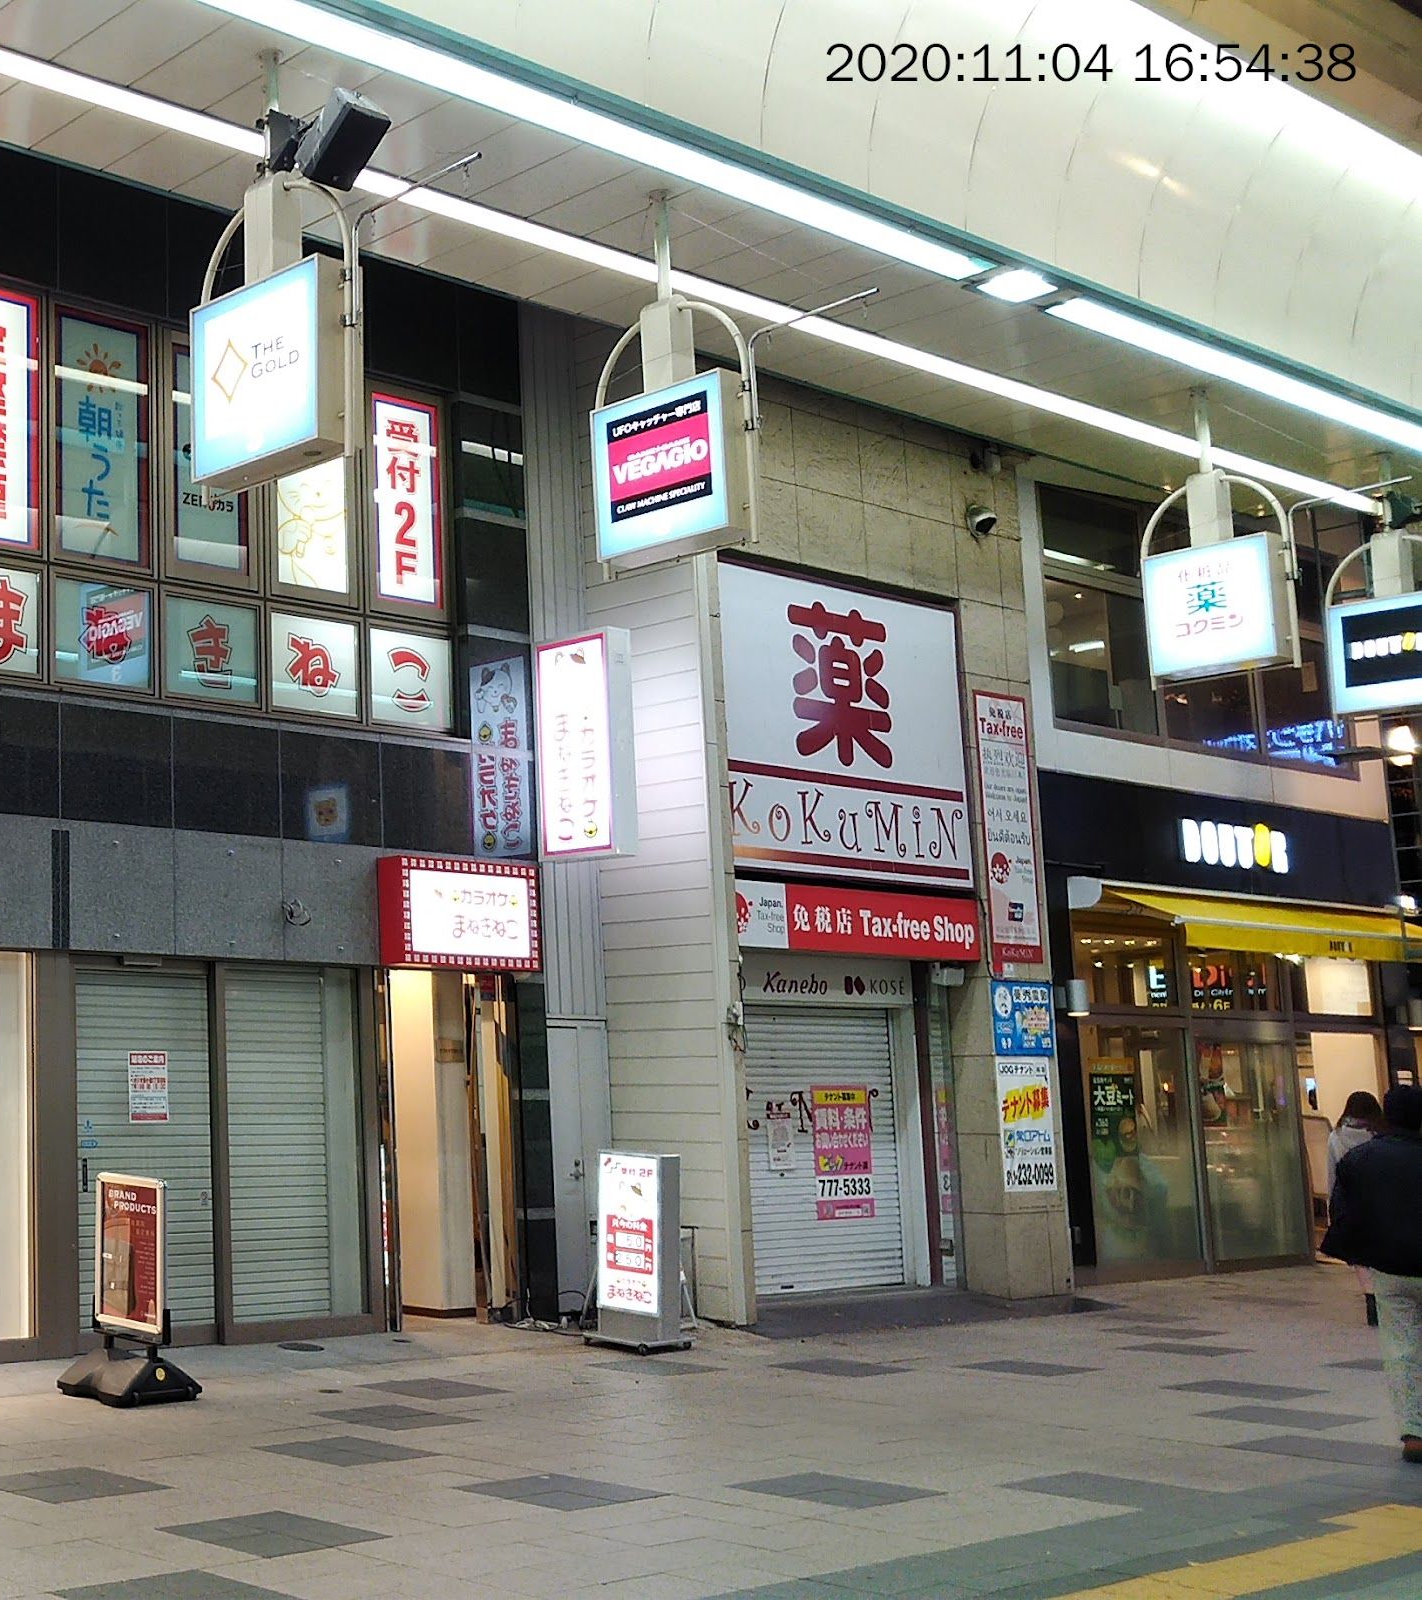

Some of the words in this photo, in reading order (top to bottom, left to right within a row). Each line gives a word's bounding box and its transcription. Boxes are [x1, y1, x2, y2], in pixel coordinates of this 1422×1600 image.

[251, 335, 285, 360] THE
[251, 349, 301, 380] GOLD
[77, 395, 113, 521] 朝うた
[612, 438, 709, 485] VEGAGIO
[1186, 580, 1228, 616] 薬
[1175, 613, 1244, 639] コクミン
[786, 600, 894, 770] 薬
[979, 717, 1024, 740] Tax-free
[1180, 817, 1290, 876] DOUTOR
[460, 887, 509, 907] カラオケ
[758, 896, 784, 909] Japan.
[451, 913, 520, 941] まねきねこ
[767, 923, 786, 936] Shop
[792, 903, 854, 936] 免税店
[858, 908, 931, 942] Tax-free
[933, 914, 975, 950] Shop
[762, 971, 828, 996] Kanebo
[870, 975, 906, 996] KOSÉ
[1001, 1085, 1050, 1122] テナント募集
[1093, 1084, 1134, 1106] 大豆ミート
[108, 1188, 137, 1201] BRAND
[818, 1177, 872, 1197] 777-5333
[113, 1200, 157, 1215] PRODUCTS
